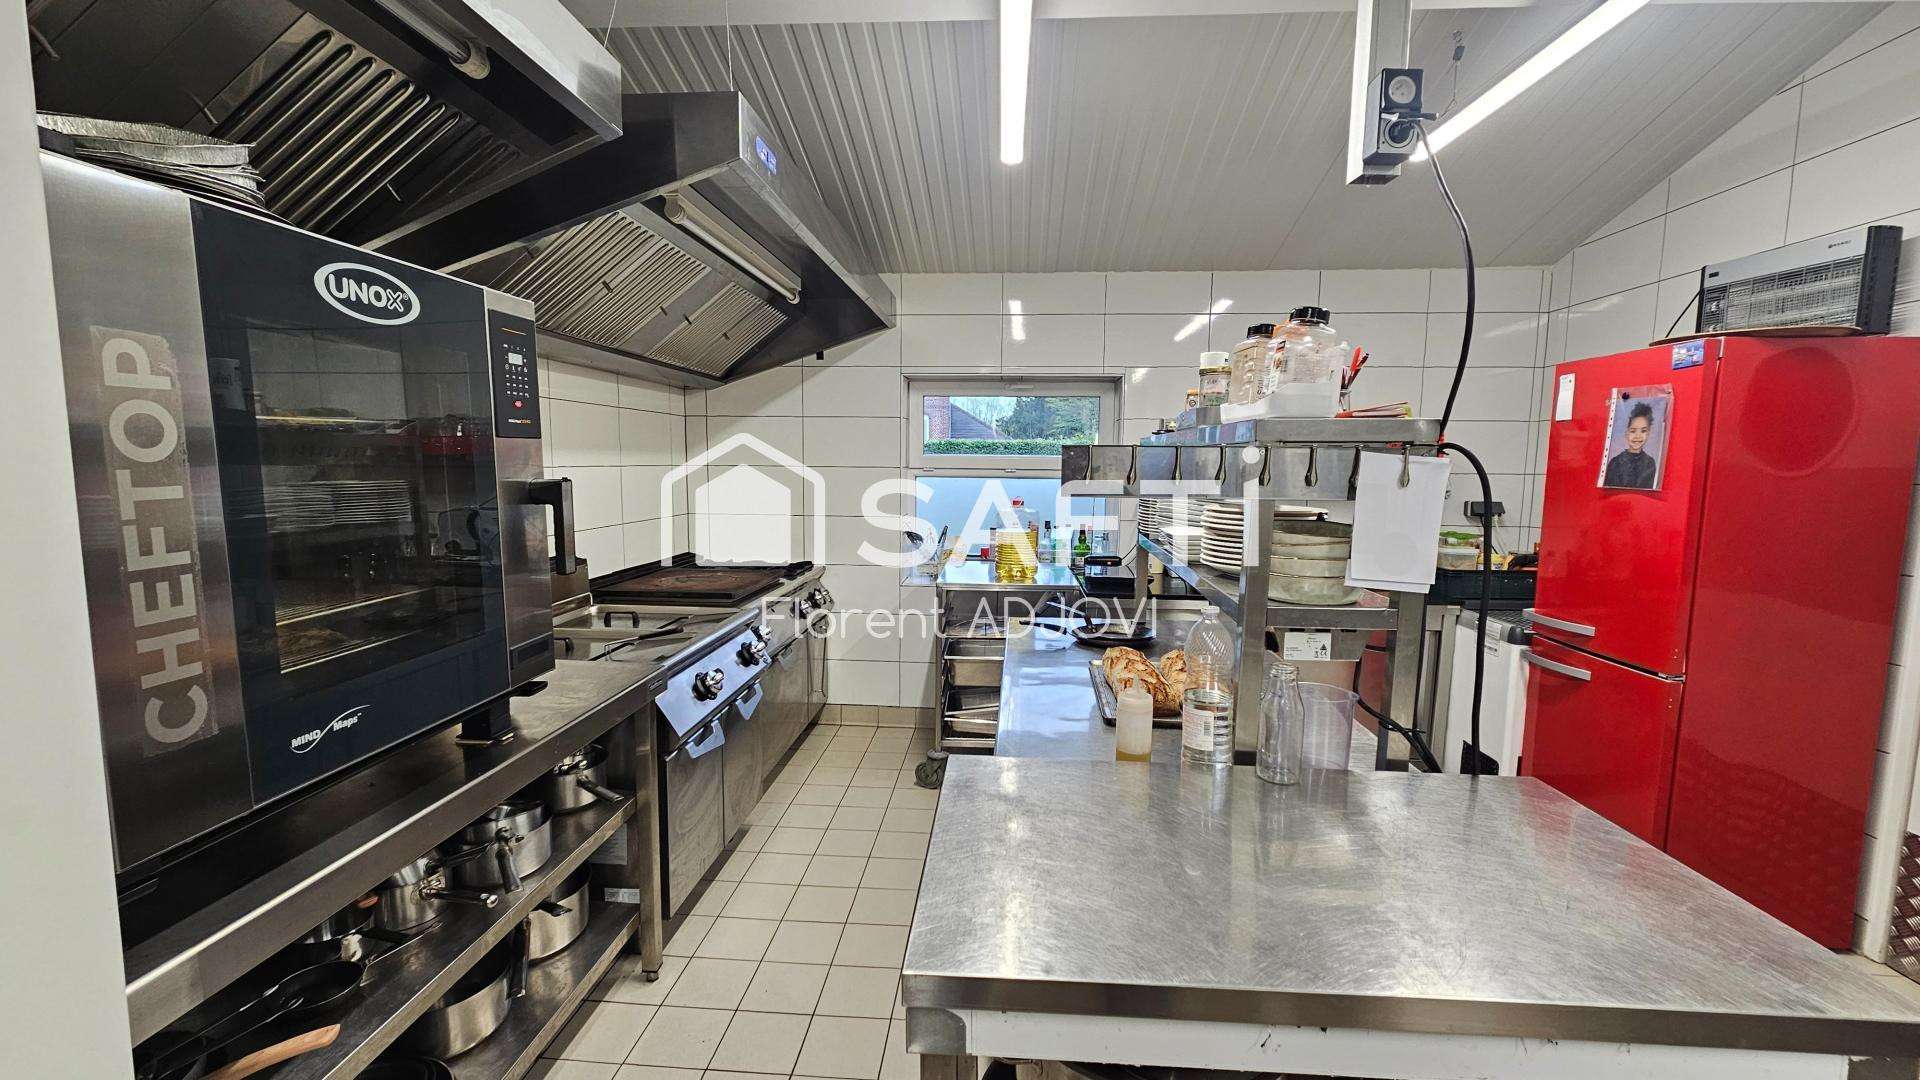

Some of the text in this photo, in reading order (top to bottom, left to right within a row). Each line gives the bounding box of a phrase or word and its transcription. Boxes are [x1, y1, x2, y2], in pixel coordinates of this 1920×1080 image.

[328, 273, 404, 312] UNOX
[101, 337, 208, 744] CHEFTOP
[291, 729, 321, 748] MIND
